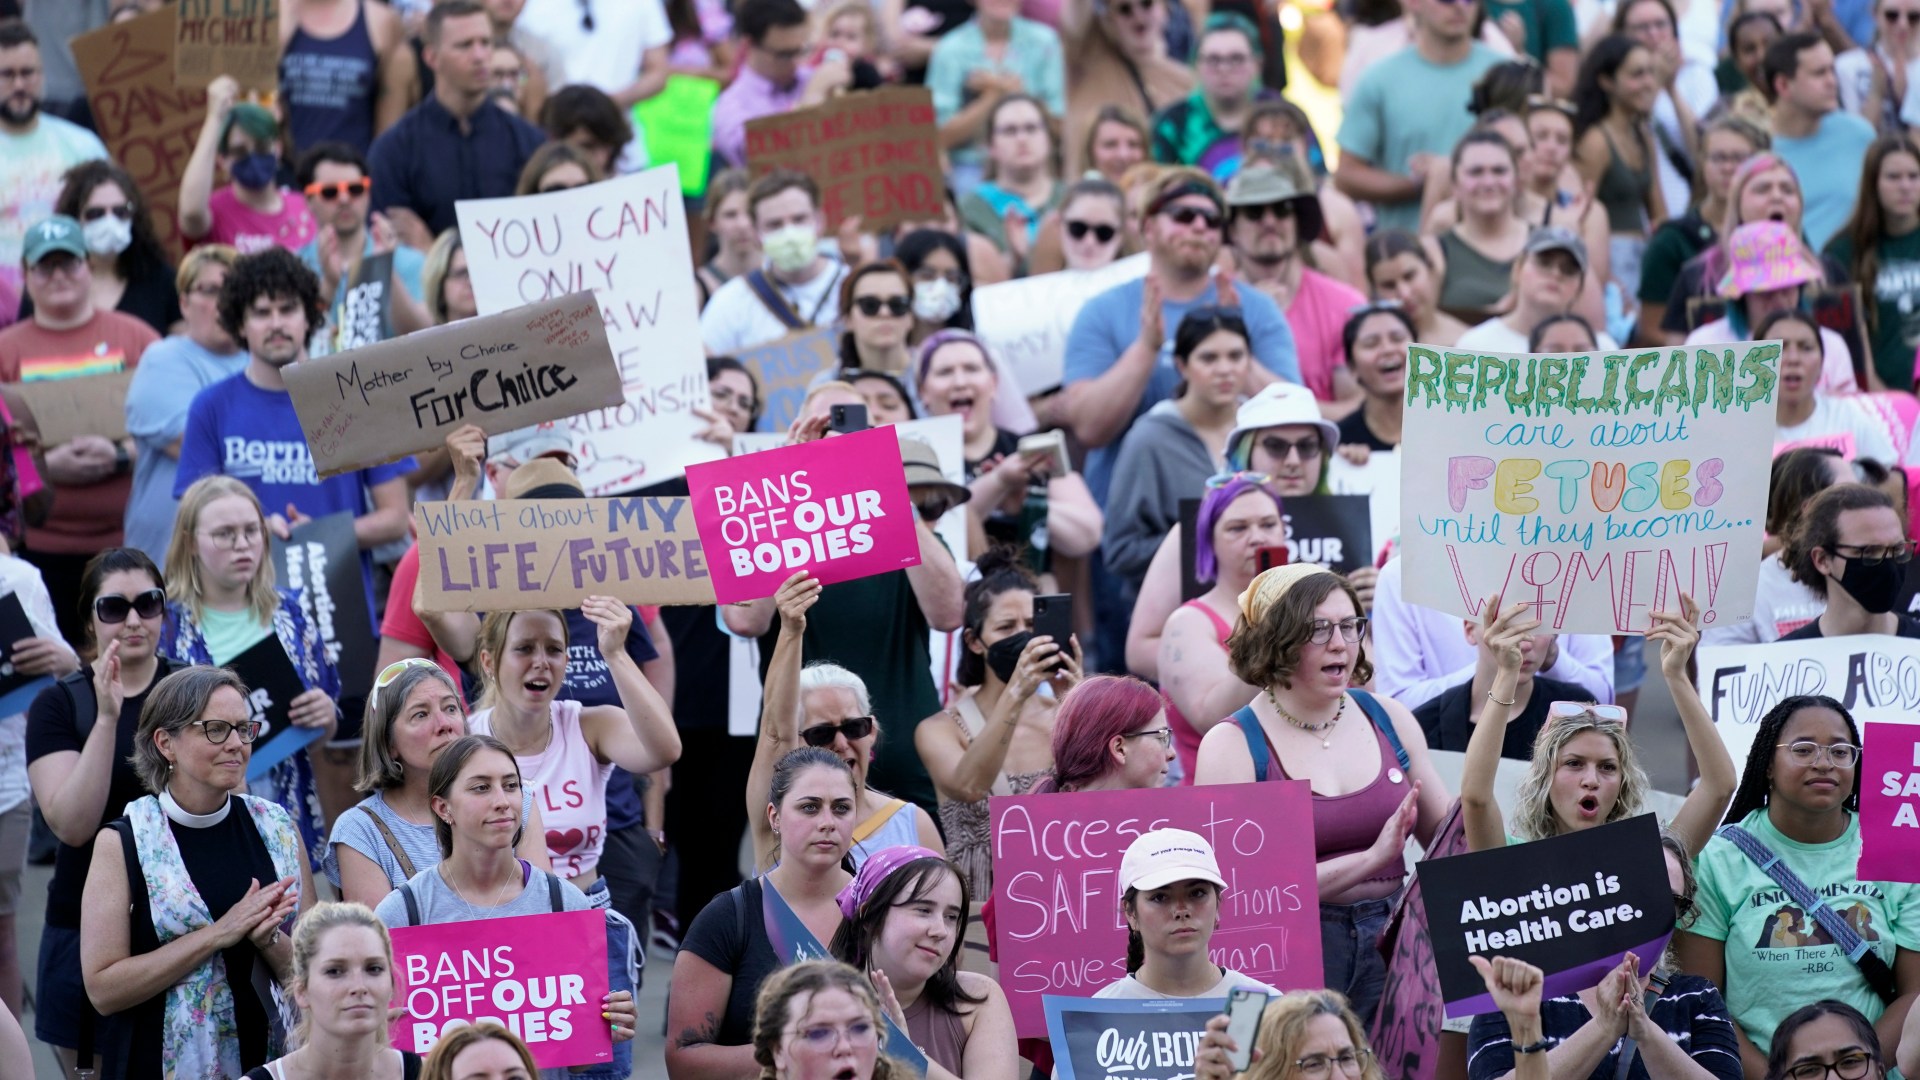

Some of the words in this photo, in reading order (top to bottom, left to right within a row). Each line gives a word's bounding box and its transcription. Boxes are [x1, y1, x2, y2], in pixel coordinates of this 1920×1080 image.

[863, 172, 942, 219] END.
[475, 213, 562, 260] YOU
[586, 188, 669, 242] CAN
[335, 360, 414, 406] Mother
[427, 355, 454, 382] by
[460, 341, 519, 361] Choice
[1407, 344, 1782, 418] REPUBLICANS
[224, 435, 313, 467] Bern
[1485, 422, 1574, 449] care
[1590, 414, 1690, 448] about
[715, 470, 813, 517] BANS
[1448, 455, 1725, 515] FETUSES
[420, 502, 505, 537] What
[519, 501, 600, 529] about
[608, 496, 686, 535] MY
[721, 506, 789, 547] OFF
[793, 489, 887, 533] OUR
[1418, 512, 1507, 546] until
[1516, 514, 1595, 550] they
[729, 523, 875, 577] BODIES
[306, 541, 336, 642] Abortion
[1446, 542, 1729, 634] WOMEN!
[564, 659, 609, 674] STAN
[1711, 658, 1828, 725] FUND
[1842, 651, 1920, 713] ABO
[543, 779, 584, 812] LS
[1880, 770, 1920, 798] SA
[1201, 801, 1265, 856] to
[1891, 802, 1920, 829] A
[1220, 867, 1302, 917] tions
[1460, 882, 1587, 926] Abortion
[1594, 871, 1622, 896] is
[1750, 889, 1792, 909] SENIO
[1465, 911, 1563, 955] Health
[1567, 898, 1644, 934] Care.
[405, 945, 515, 987] BANS
[1207, 943, 1276, 973] man
[1795, 949, 1826, 960] There
[1830, 946, 1848, 958] Ar
[1801, 961, 1834, 974] -RBG
[407, 982, 486, 1020] OFF
[491, 974, 587, 1012] OUR
